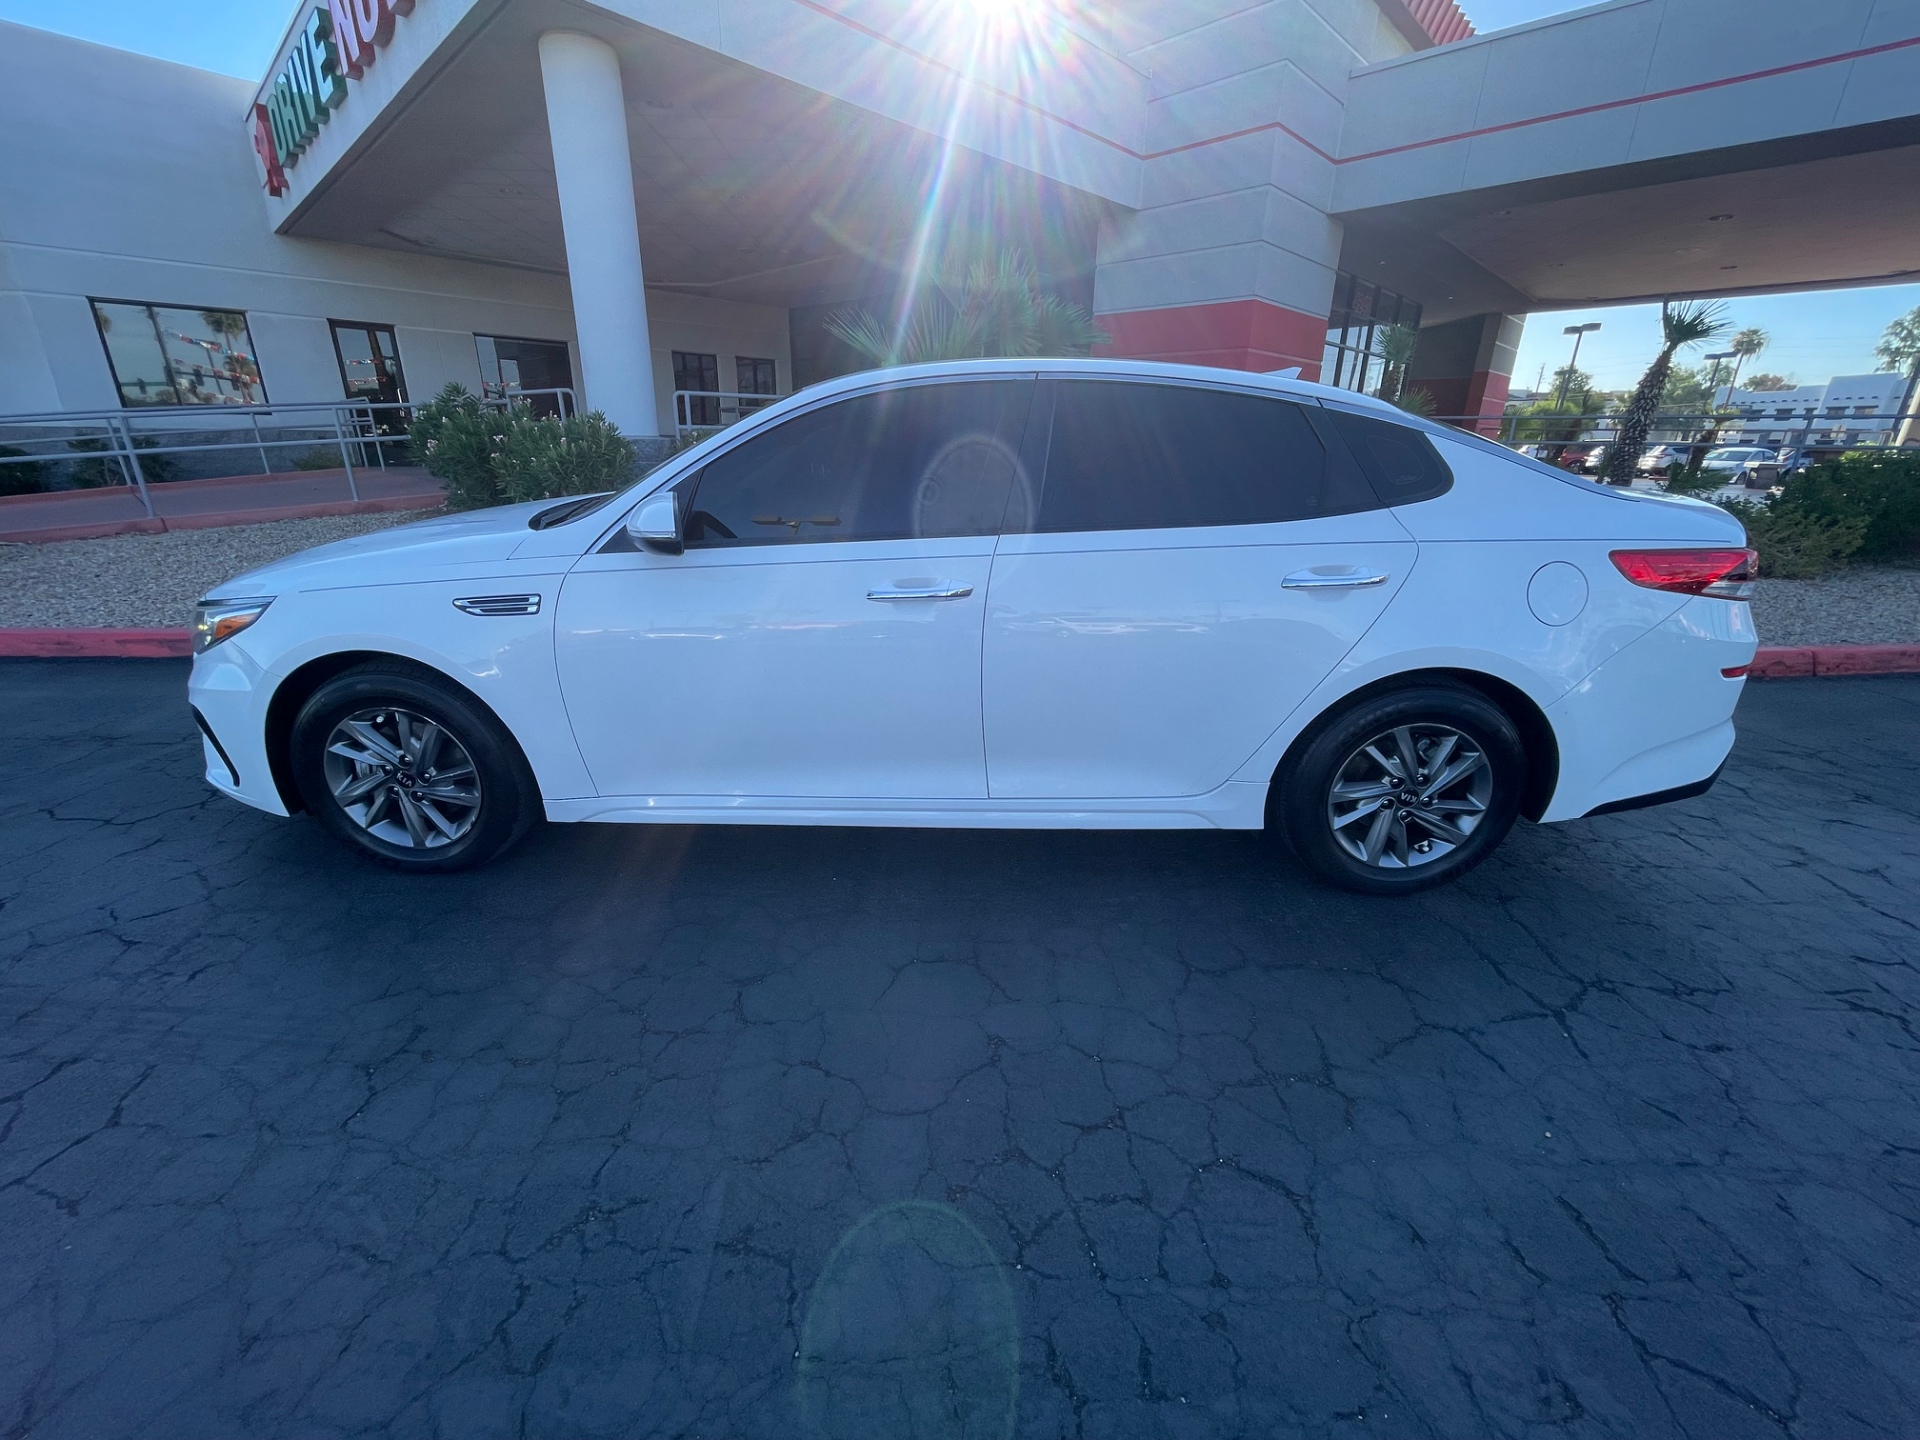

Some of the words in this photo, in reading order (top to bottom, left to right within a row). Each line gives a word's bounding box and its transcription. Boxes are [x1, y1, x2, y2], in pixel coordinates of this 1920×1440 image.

[265, 6, 342, 168] DRIVE
[396, 770, 412, 787] KIA
[1401, 792, 1417, 803] KIA
